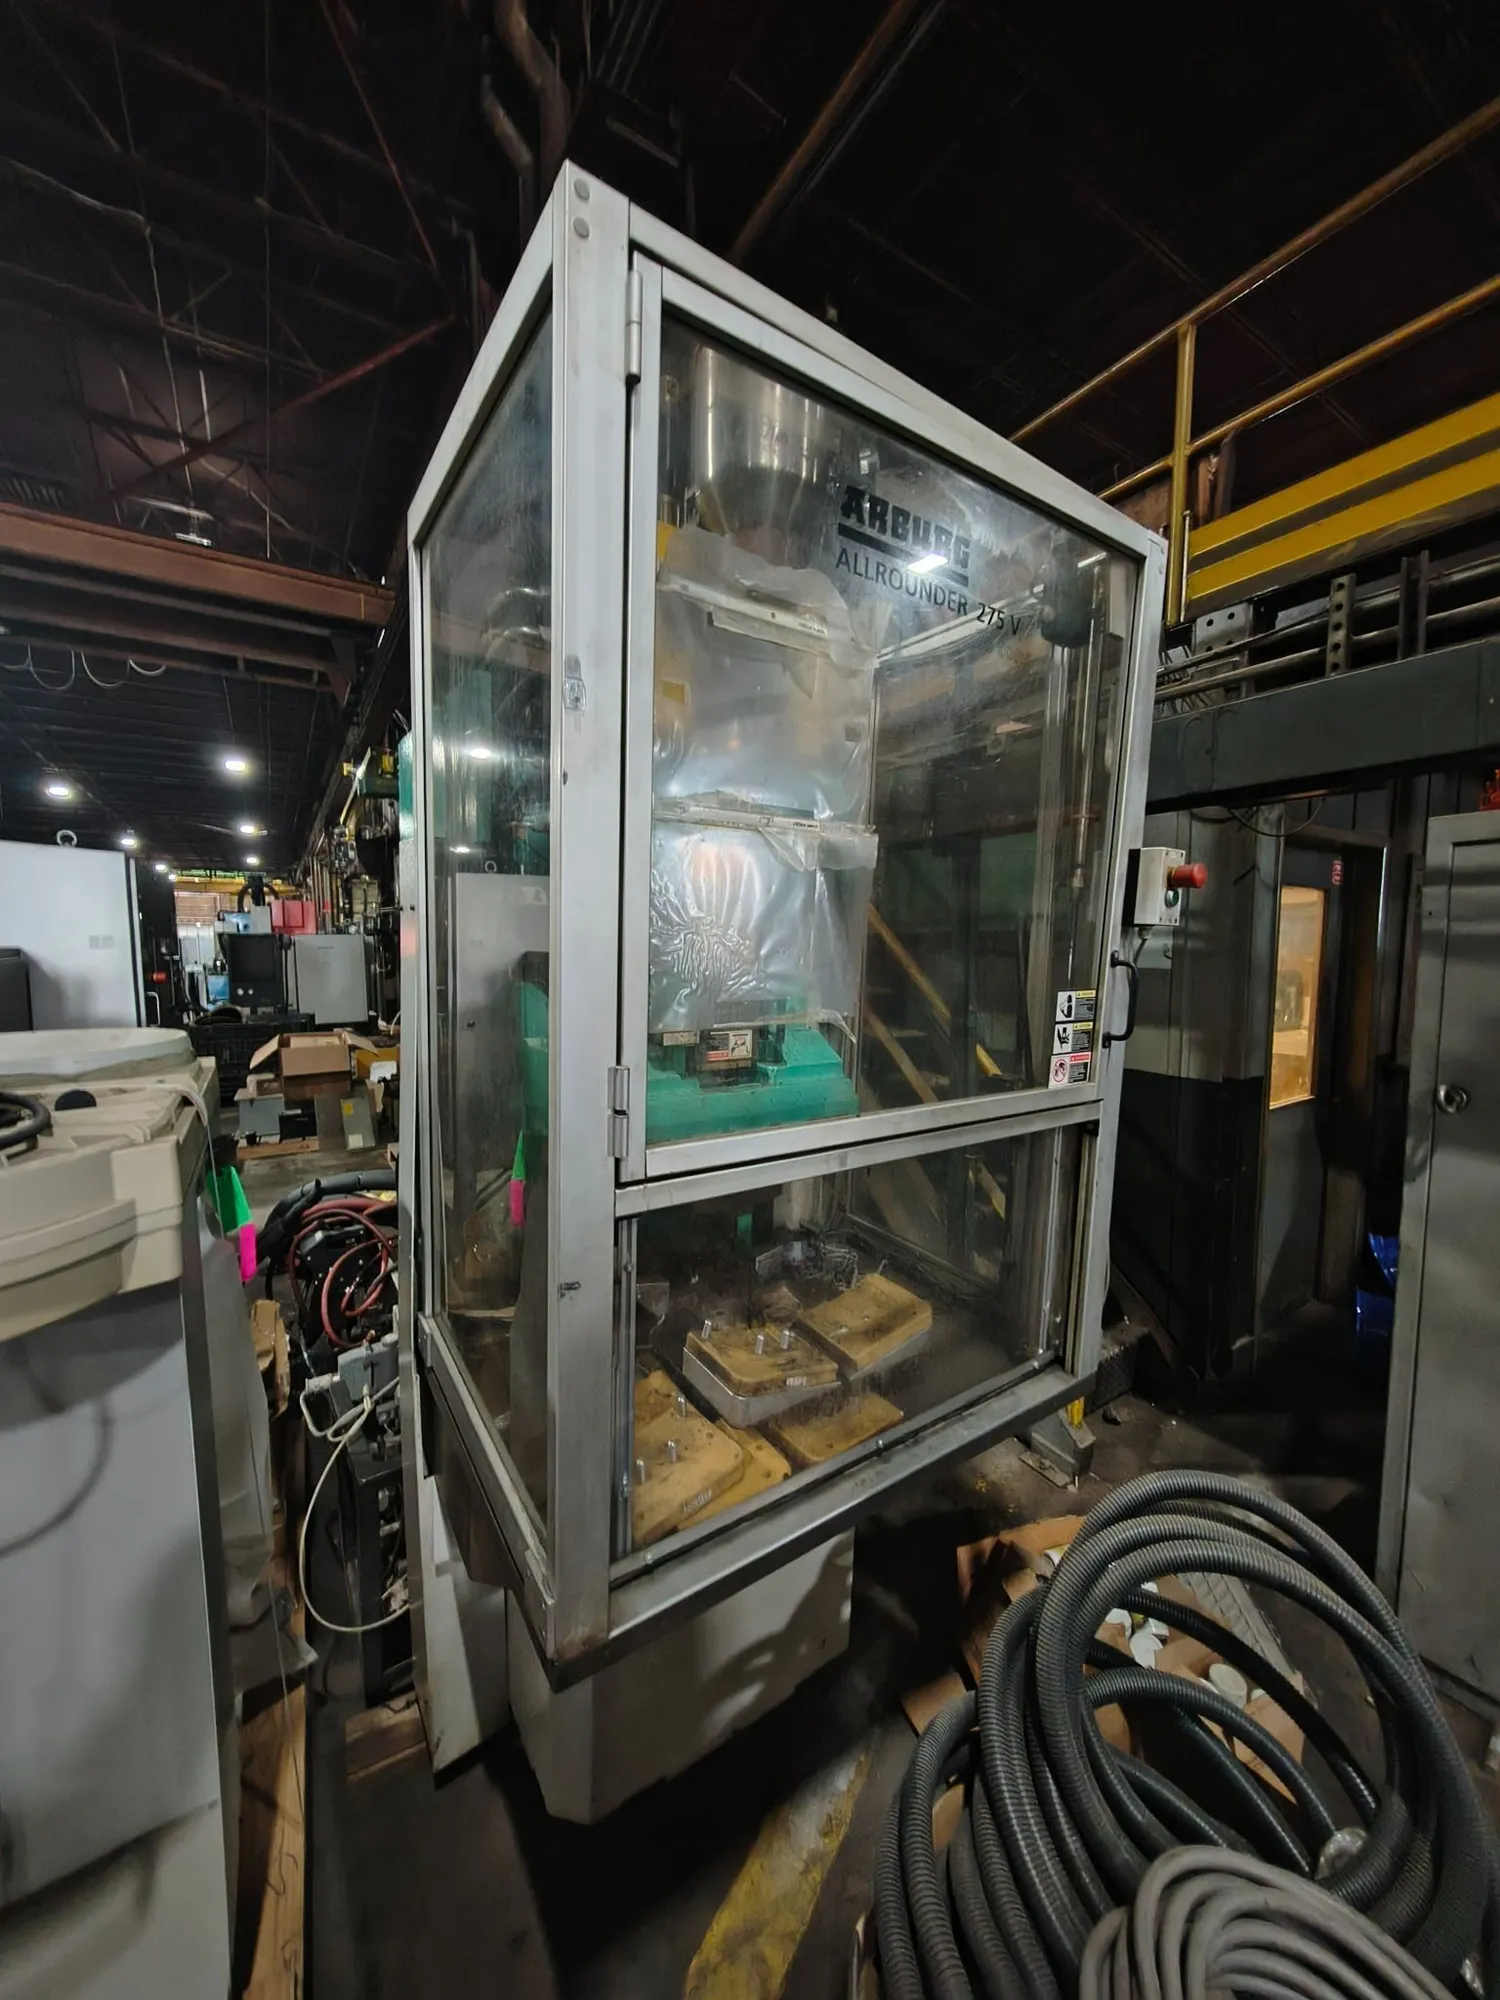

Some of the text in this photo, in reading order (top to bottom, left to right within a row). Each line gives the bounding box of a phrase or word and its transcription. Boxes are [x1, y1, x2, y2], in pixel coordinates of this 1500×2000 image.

[840, 485, 970, 569] ARBURG
[835, 547, 1022, 636] ALLROUNDER 275 V
